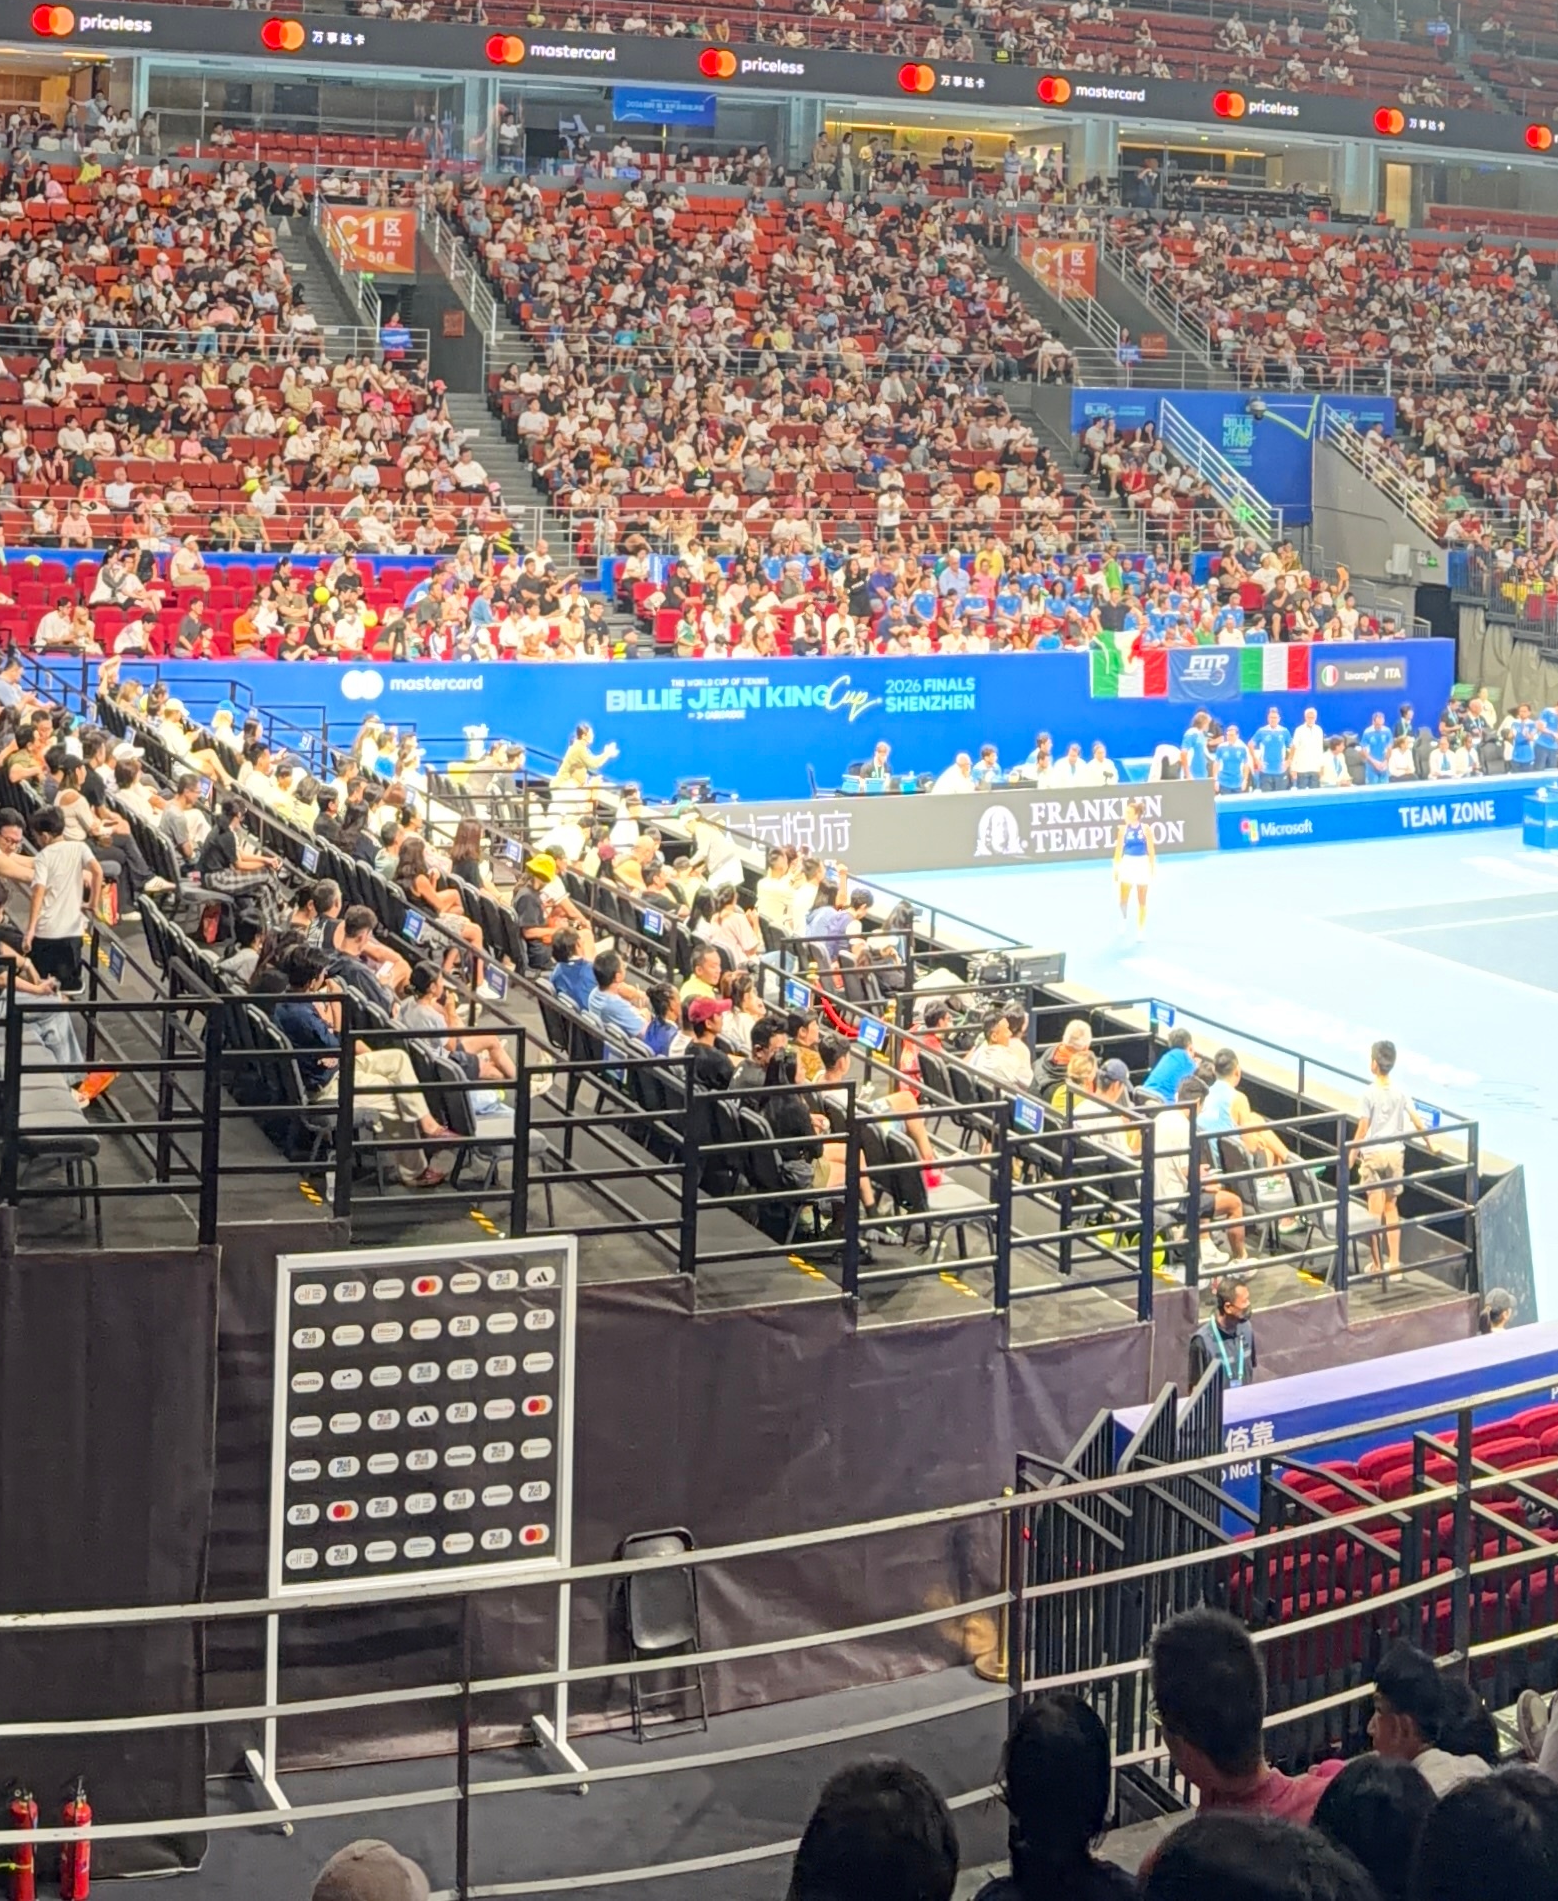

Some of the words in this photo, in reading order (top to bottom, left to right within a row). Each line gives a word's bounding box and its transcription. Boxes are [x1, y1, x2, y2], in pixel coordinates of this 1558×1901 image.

[79, 13, 153, 33] priceless
[530, 44, 616, 62] mastercard
[741, 56, 805, 75] priceless
[1075, 85, 1146, 102] mastercard
[1248, 99, 1299, 117] priceless
[337, 214, 402, 247] C1区
[1189, 653, 1230, 669] FITP
[1385, 668, 1402, 679] ITA
[390, 675, 484, 691] mastercard
[886, 679, 921, 694] 2026
[923, 677, 976, 693] FINALS
[606, 688, 682, 713] BILLIE
[688, 686, 760, 712] JEAN
[765, 684, 829, 708] KING
[826, 675, 878, 722] Cup
[886, 695, 976, 713] SHENZHEN
[1398, 804, 1447, 830] TEAM
[1450, 800, 1496, 825] ZONE
[1260, 818, 1314, 838] Microsoft
[1030, 820, 1186, 855] TEMPLON
[1230, 1461, 1254, 1481] Not
